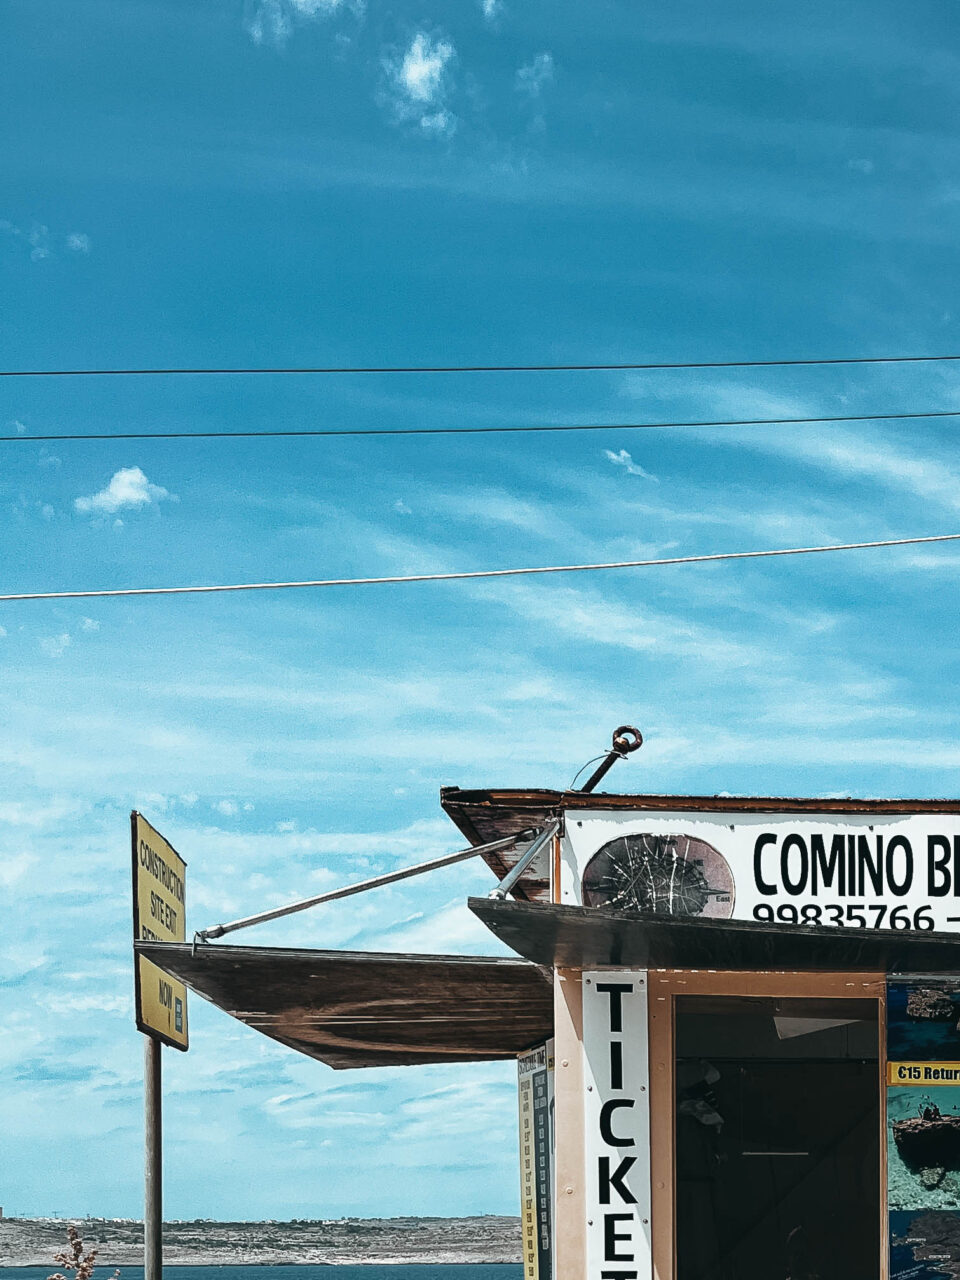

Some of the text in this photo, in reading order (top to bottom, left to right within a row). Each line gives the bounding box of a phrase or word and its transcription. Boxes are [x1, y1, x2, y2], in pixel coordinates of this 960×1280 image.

[141, 839, 184, 905] CONSTRUCTION
[753, 833, 913, 897] COMINO
[151, 890, 164, 925] SITE
[165, 902, 177, 936] EXIT
[752, 903, 935, 931] 99835766
[159, 978, 172, 1010] NOW
[898, 1066, 921, 1079] €15
